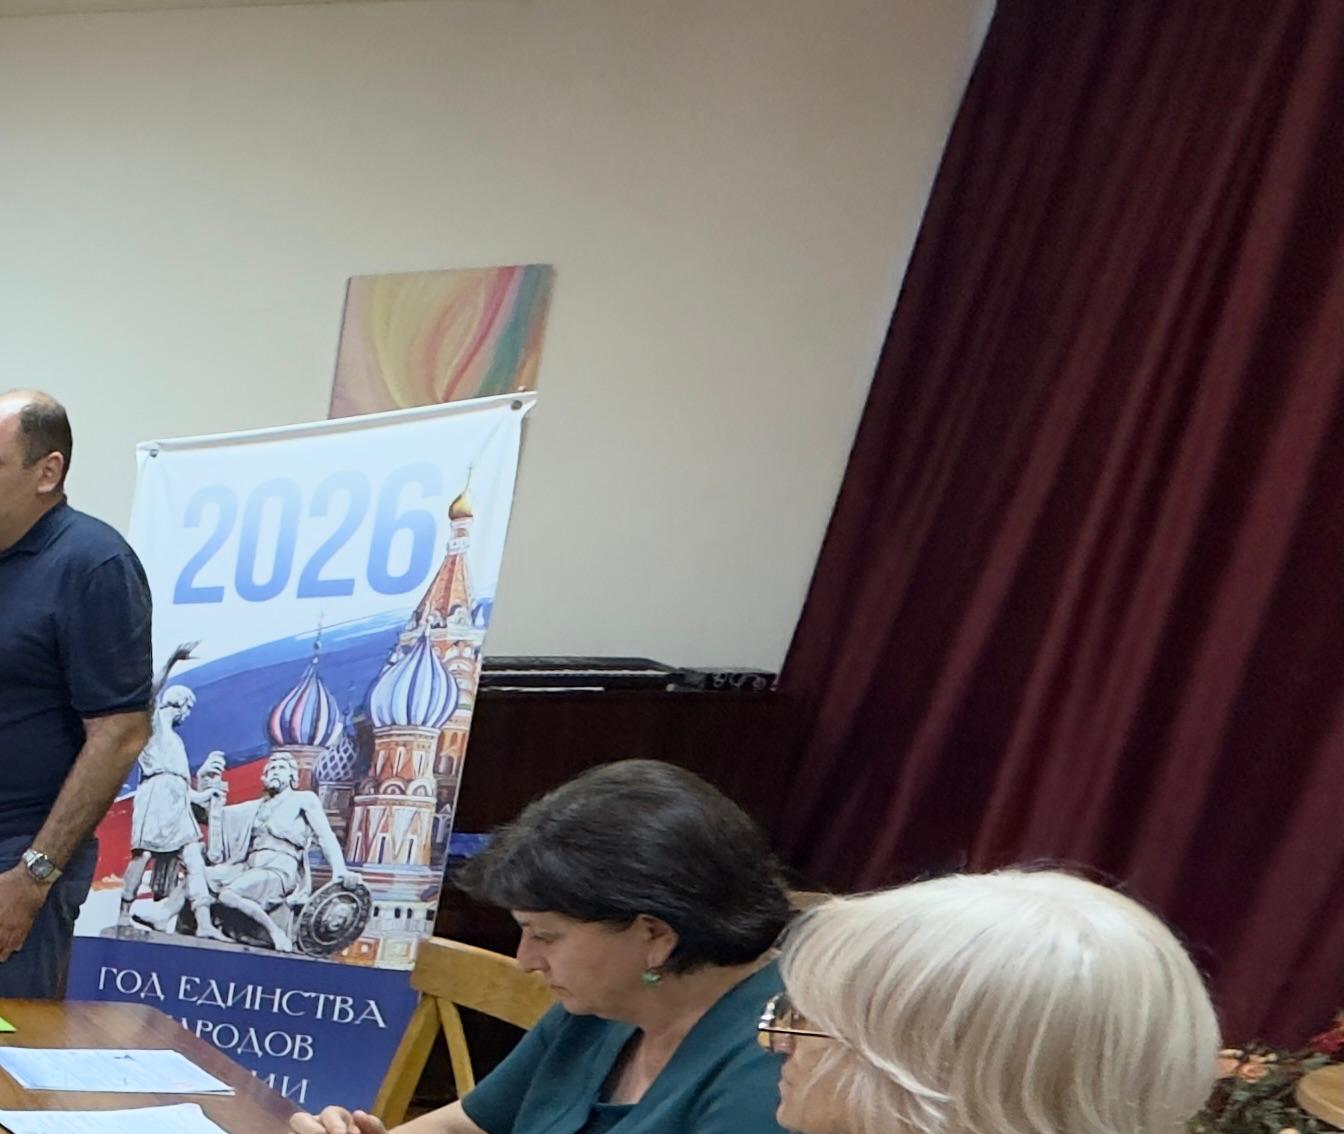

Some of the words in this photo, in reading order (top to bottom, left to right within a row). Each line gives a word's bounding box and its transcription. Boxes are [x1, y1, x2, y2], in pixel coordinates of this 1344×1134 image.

[173, 462, 444, 605] 2026
[98, 966, 165, 1001] ГОД
[177, 975, 387, 1029] ЕДИНСТВА
[167, 1015, 314, 1062] РОДОВ
